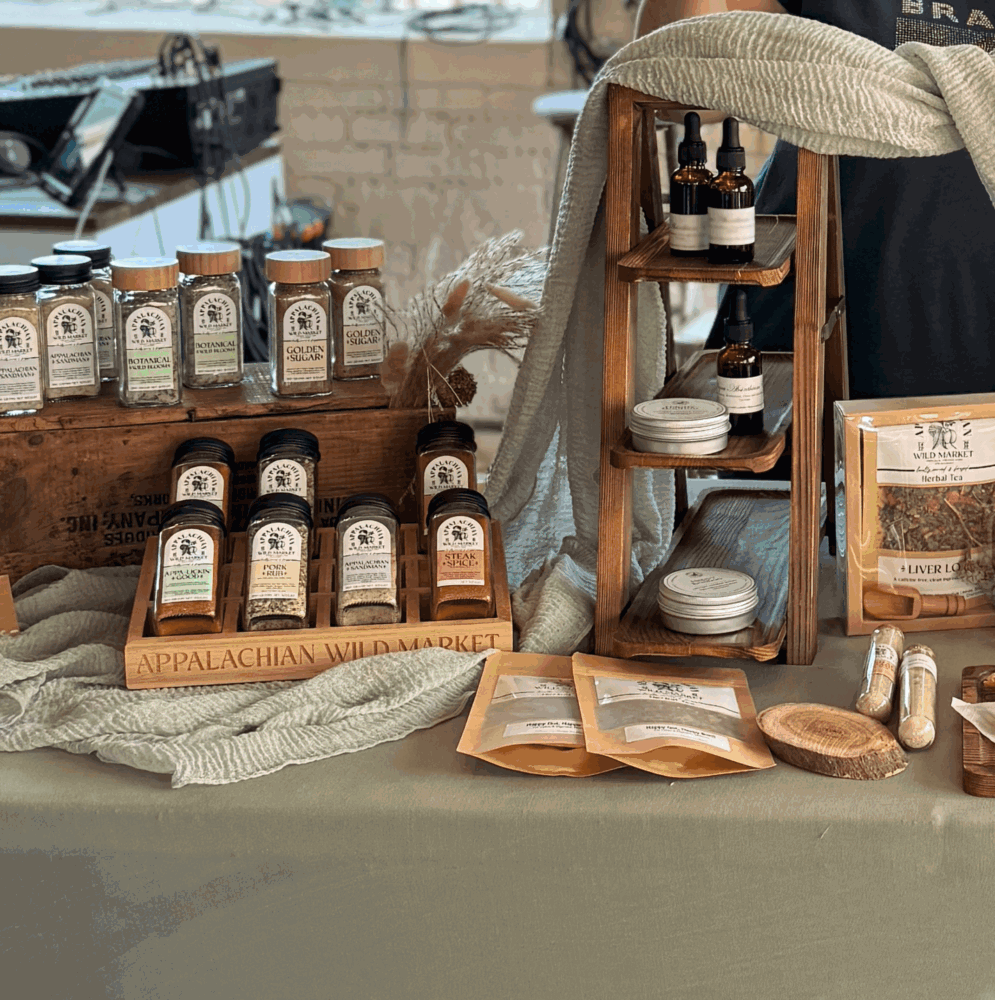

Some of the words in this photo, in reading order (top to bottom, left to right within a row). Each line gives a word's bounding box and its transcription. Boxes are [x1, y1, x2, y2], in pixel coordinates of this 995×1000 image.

[346, 328, 381, 339] GOLDEN
[196, 340, 237, 349] BOTANICAL
[350, 336, 378, 345] SUGAR
[286, 345, 324, 355] GOLDEN
[128, 357, 171, 365] BOTANICAL
[290, 353, 321, 362] SUGAR
[913, 452, 936, 460] WILD
[938, 450, 974, 458] MARKET
[345, 559, 389, 567] APPALACHIAN
[446, 559, 475, 567] SPICE
[908, 564, 942, 575] LIVER
[136, 644, 315, 675] APPALACHIAN
[324, 639, 389, 662] WILD
[397, 633, 500, 652] MARKET
